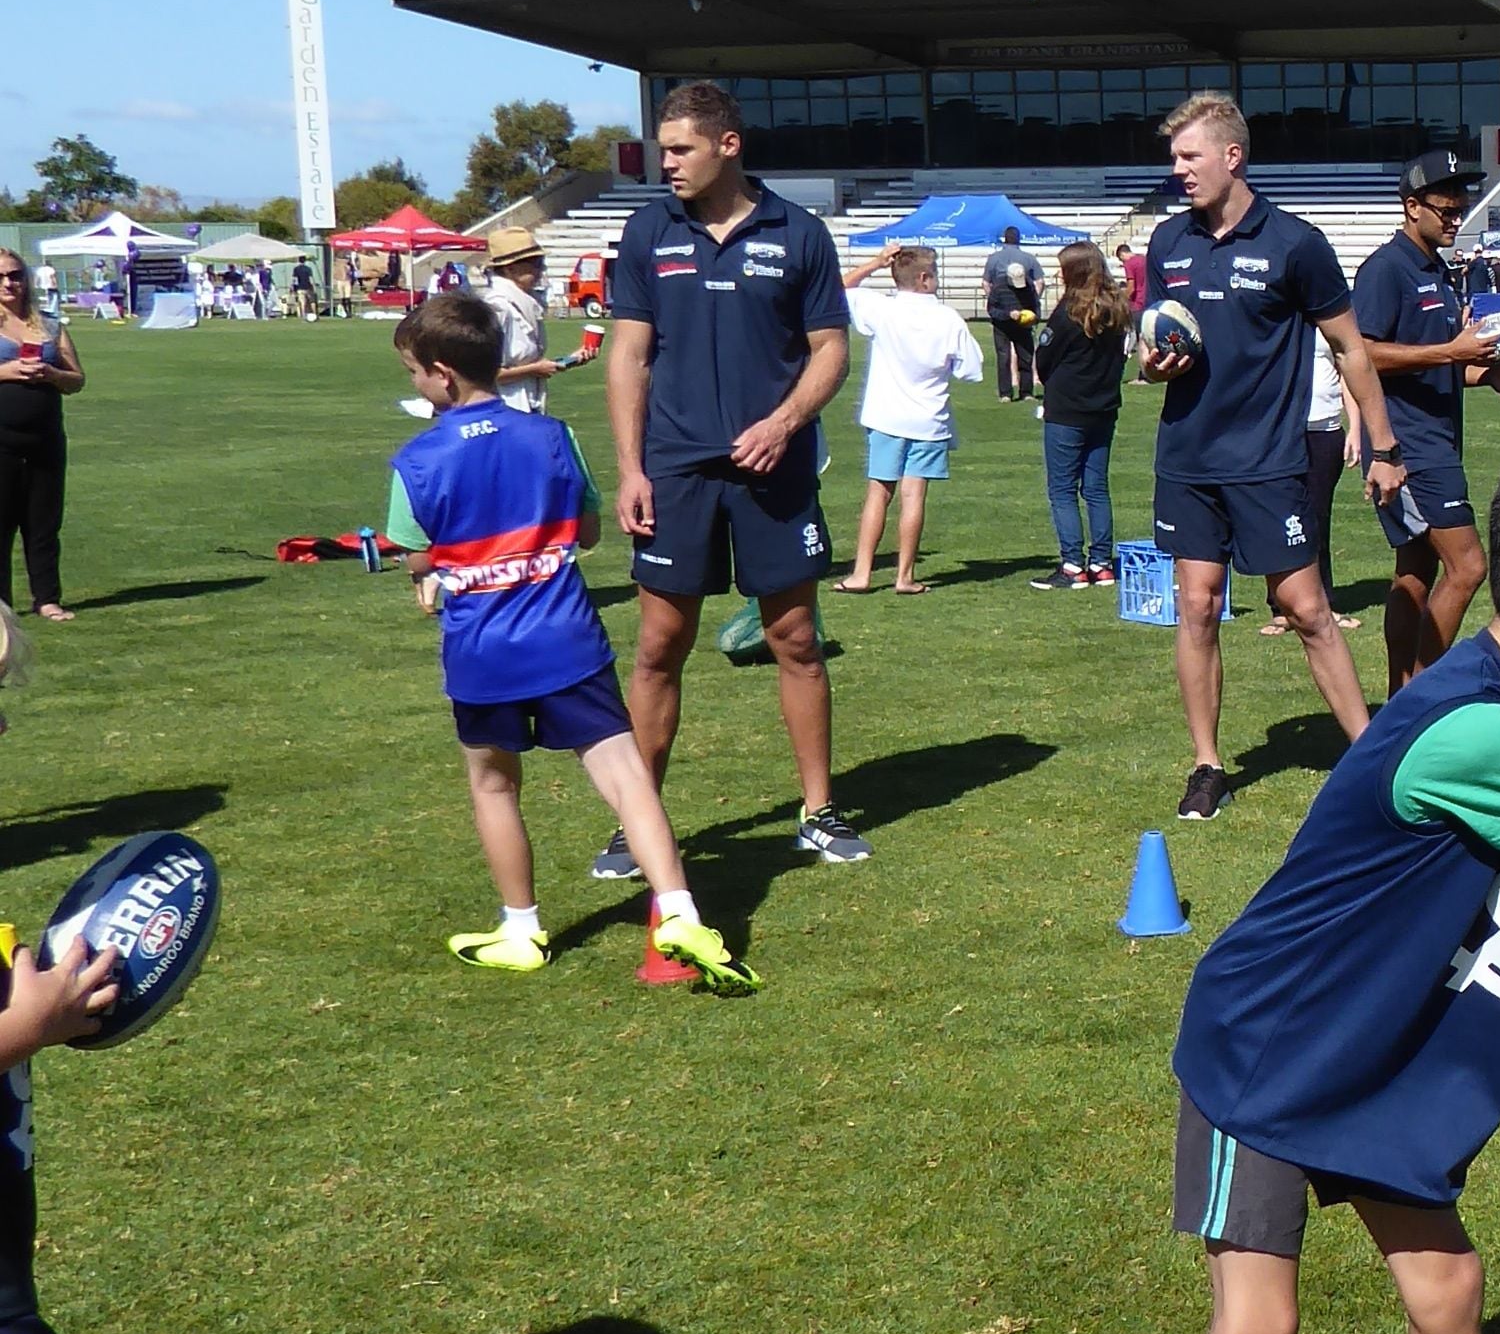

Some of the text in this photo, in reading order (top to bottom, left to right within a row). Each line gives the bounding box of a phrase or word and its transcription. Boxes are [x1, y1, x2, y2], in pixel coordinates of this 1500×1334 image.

[1069, 42, 1189, 57] GRANDSTAND
[306, 112, 326, 221] Estate
[460, 419, 498, 440] F.F.C.
[142, 910, 178, 956] AFL
[179, 894, 206, 941] BRAND
